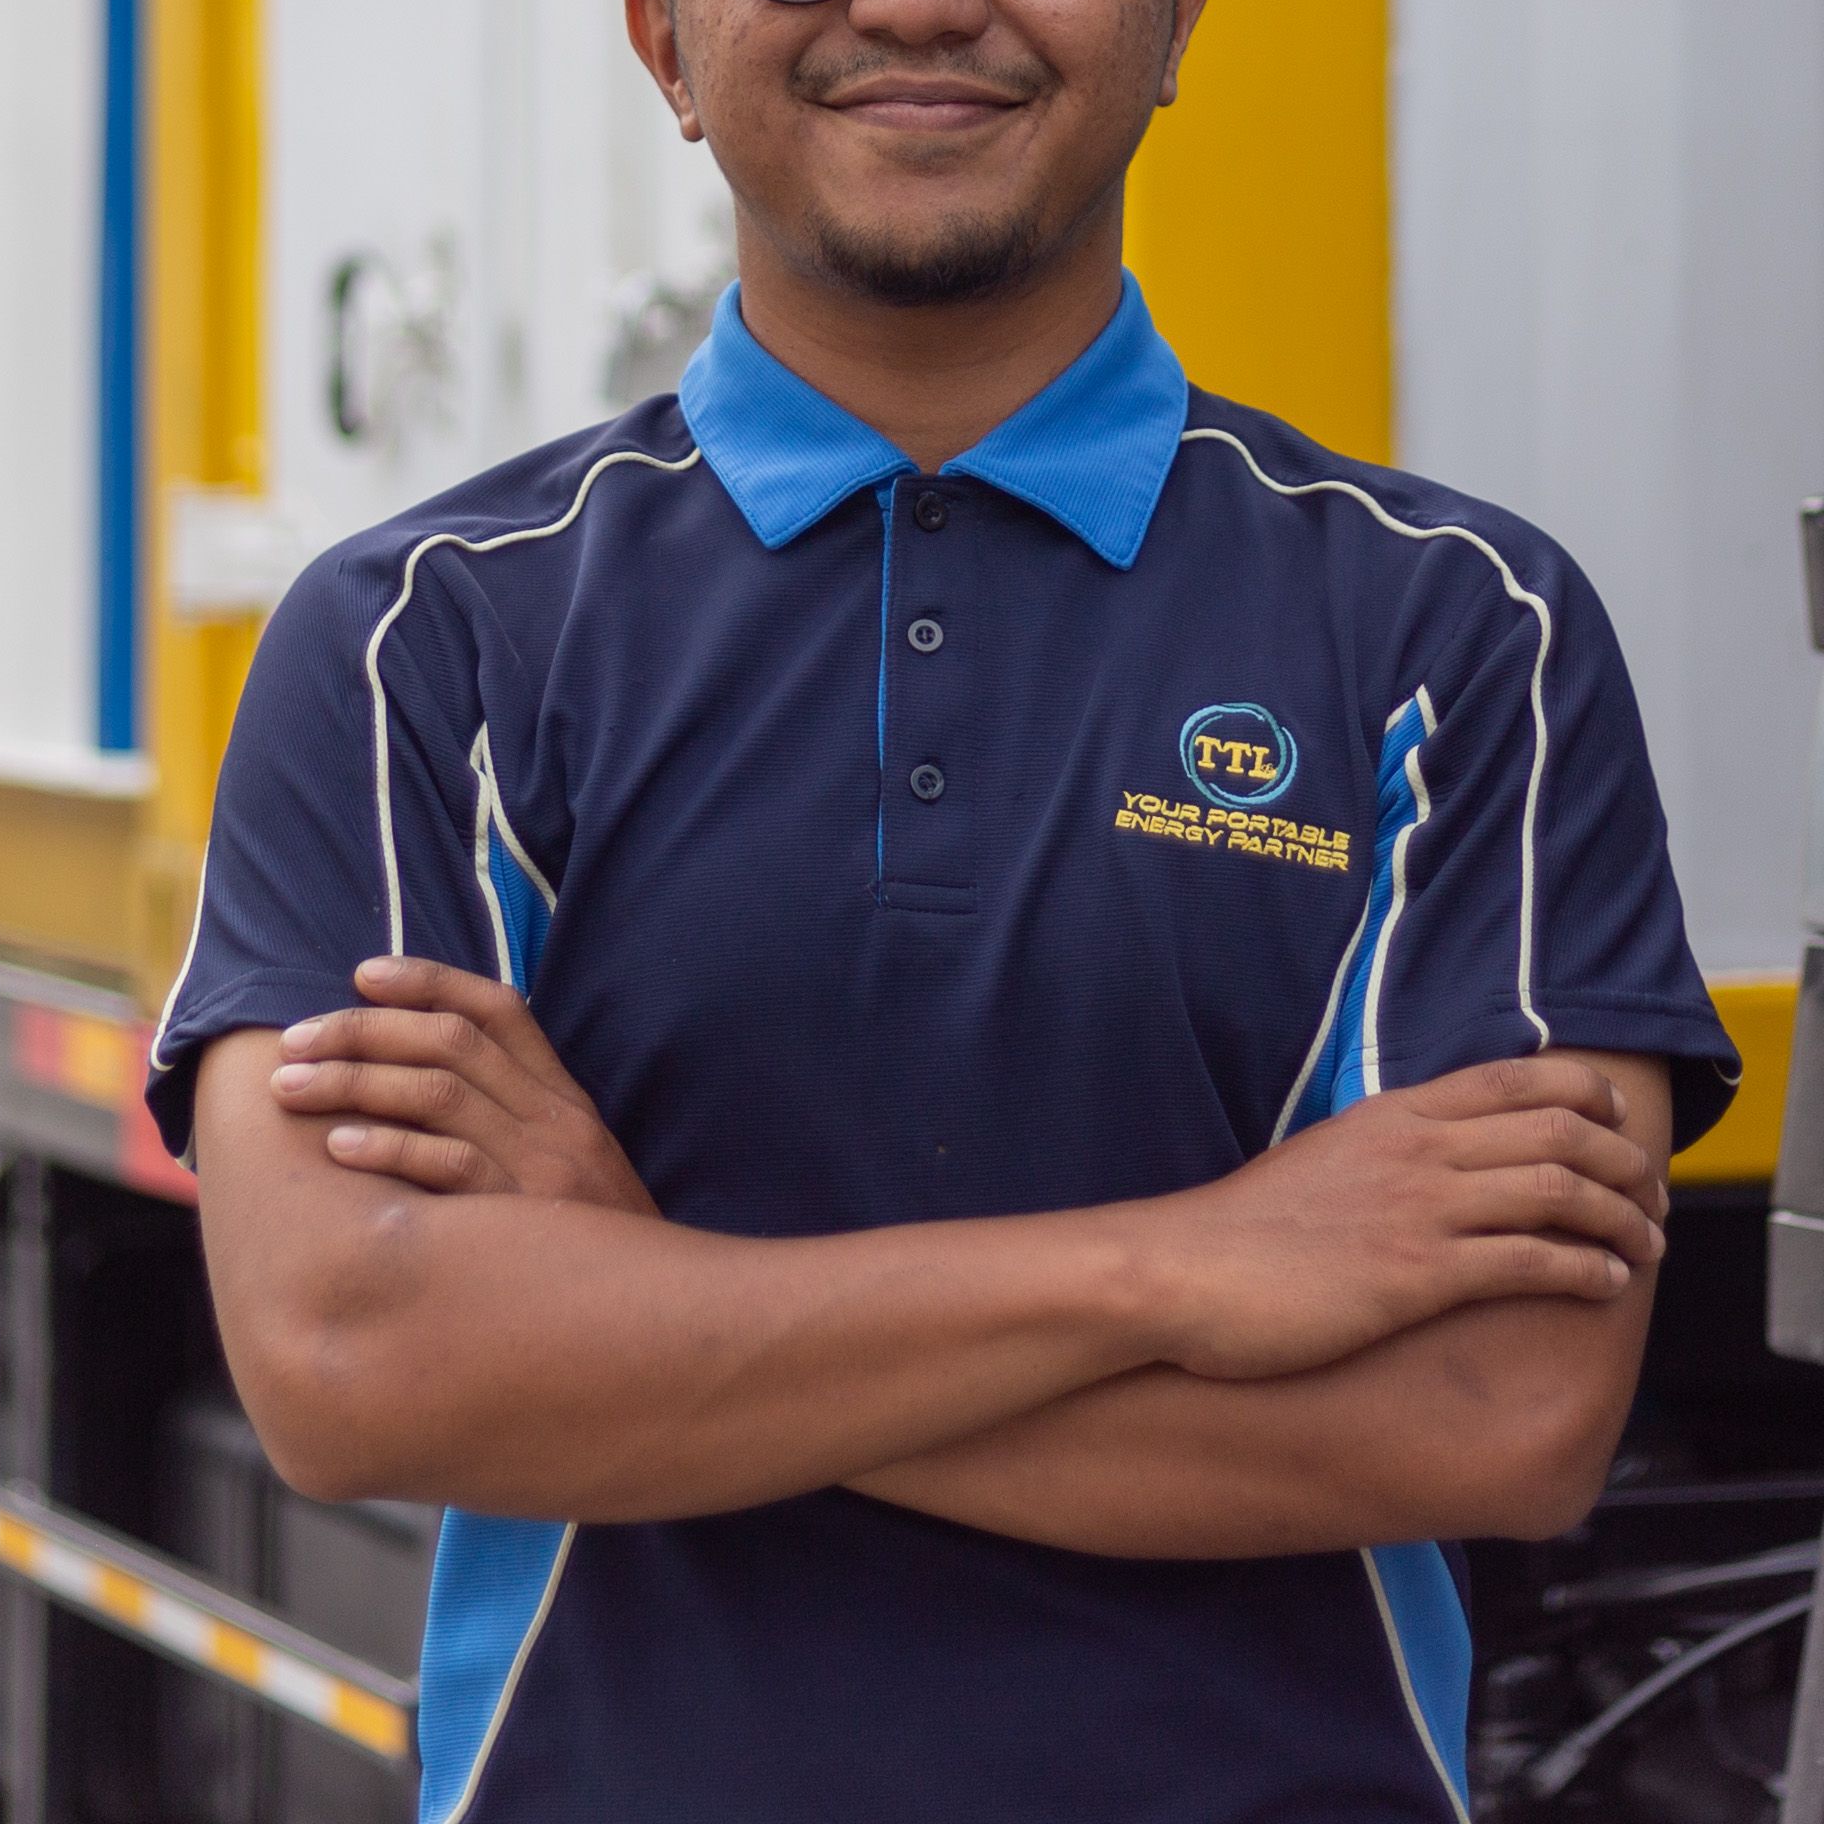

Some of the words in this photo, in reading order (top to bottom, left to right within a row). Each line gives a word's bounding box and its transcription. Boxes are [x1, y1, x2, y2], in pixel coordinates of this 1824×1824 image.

[1194, 734, 1277, 780] TTL
[1114, 808, 1224, 846] ENERGY
[1227, 830, 1350, 872] PARTNER
[1122, 790, 1201, 823] YOUR
[1205, 807, 1351, 851] PORTABLE
